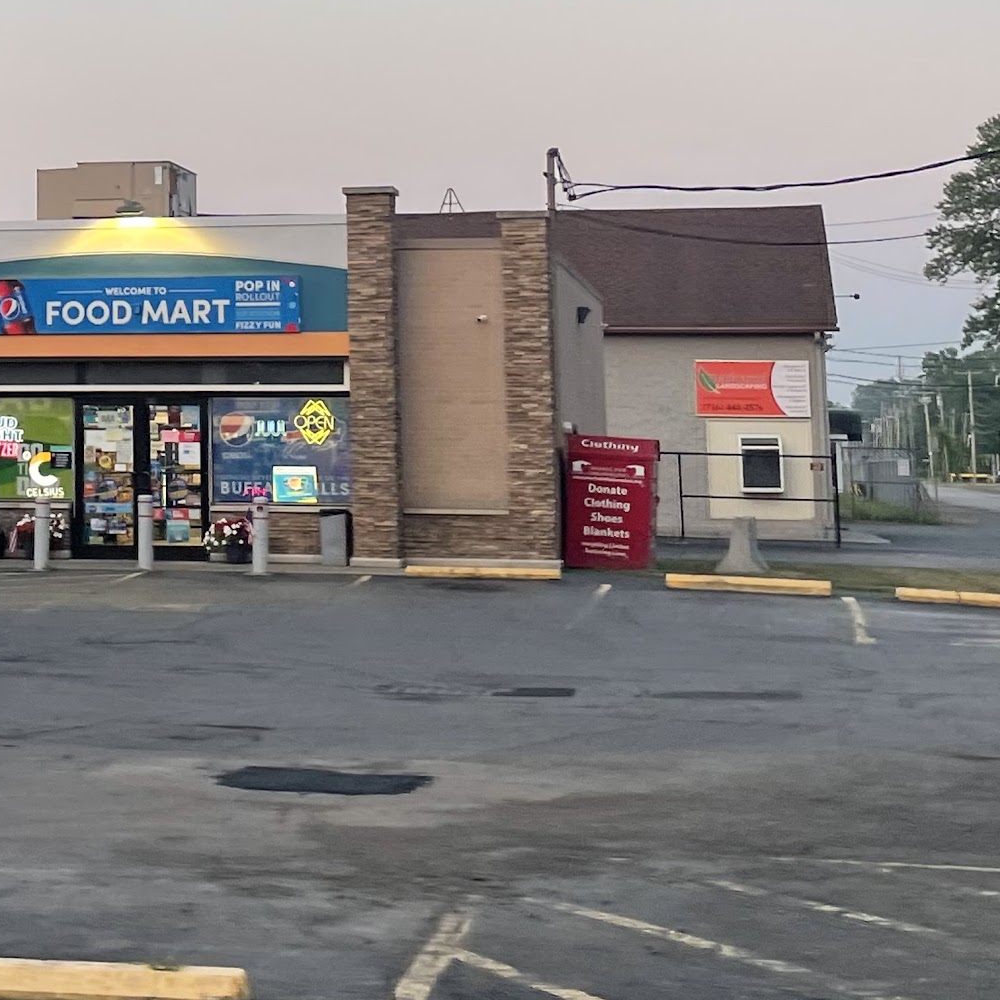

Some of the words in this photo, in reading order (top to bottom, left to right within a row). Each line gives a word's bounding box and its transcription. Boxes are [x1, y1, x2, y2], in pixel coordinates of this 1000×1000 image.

[105, 287, 151, 295] WELCOME
[154, 287, 167, 295] TO
[235, 280, 264, 292] POP
[266, 280, 280, 292] IN
[46, 300, 132, 325] FOOD
[141, 299, 230, 325] MART
[263, 321, 281, 329] FUN
[294, 415, 334, 430] OPEN
[26, 487, 65, 498] CELSIUS
[588, 483, 628, 496] Donate
[584, 497, 631, 512] Clothing
[590, 512, 623, 523] Shoes
[583, 526, 630, 539] Blankets
